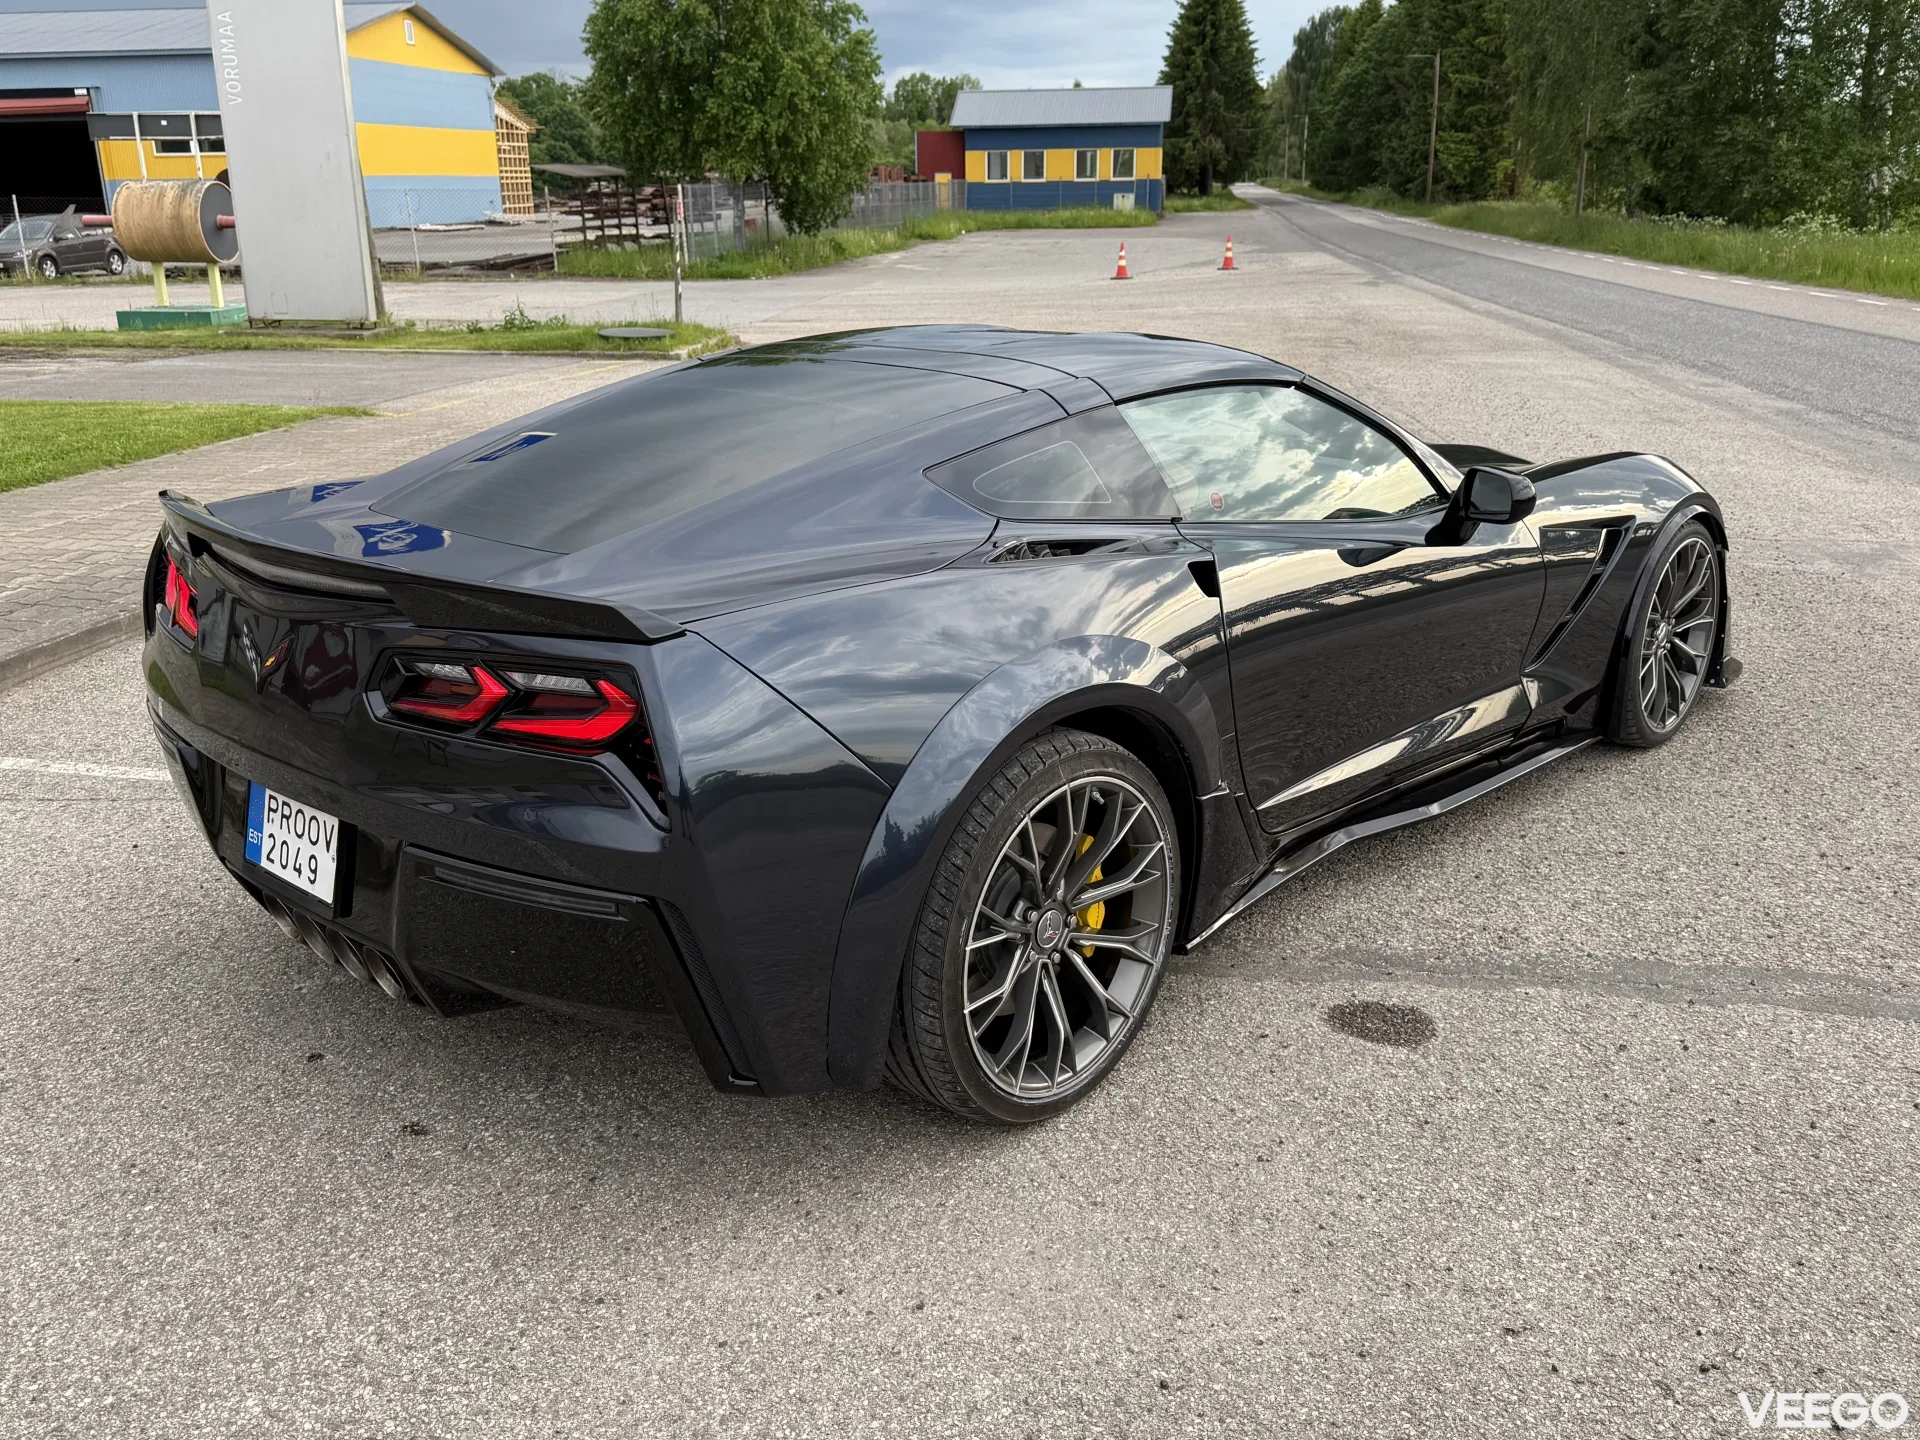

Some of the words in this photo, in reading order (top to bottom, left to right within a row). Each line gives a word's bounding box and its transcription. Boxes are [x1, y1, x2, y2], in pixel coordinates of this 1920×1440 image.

[248, 828, 263, 846] EST
[266, 794, 335, 854] PROOV
[266, 832, 319, 885] 2049
